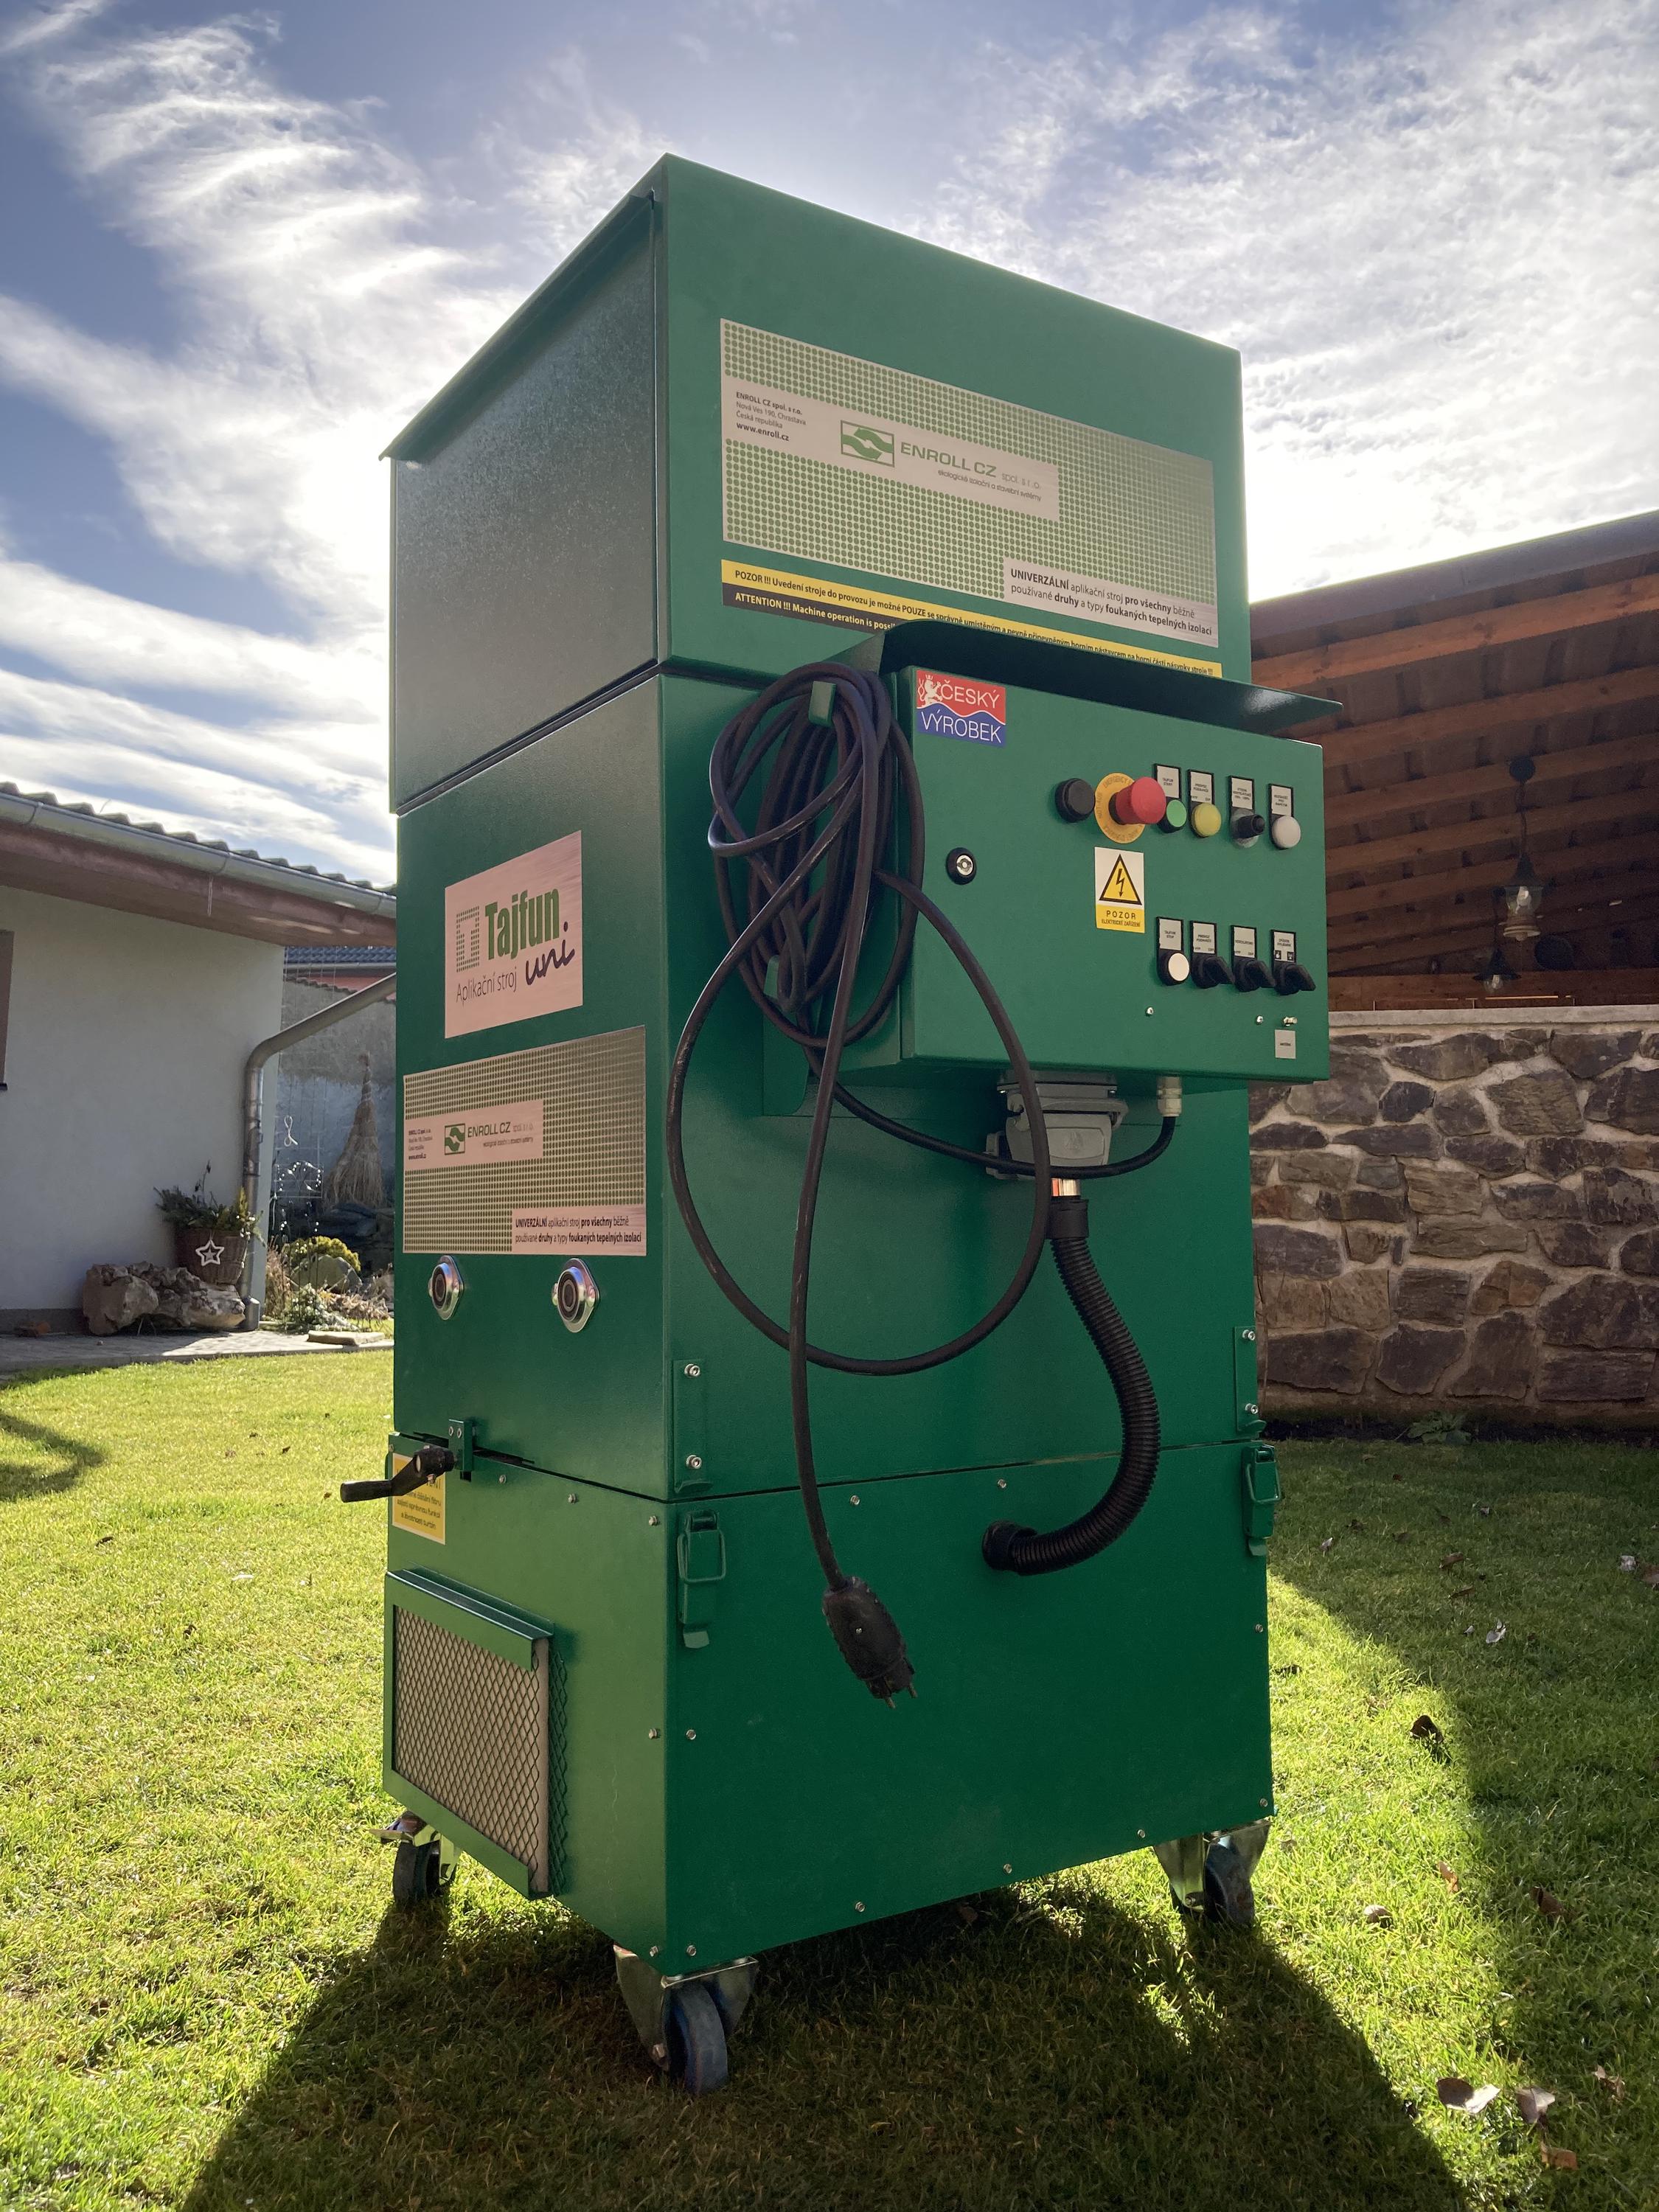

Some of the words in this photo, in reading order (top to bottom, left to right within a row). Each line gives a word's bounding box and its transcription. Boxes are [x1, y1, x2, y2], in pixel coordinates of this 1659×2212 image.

[737, 392, 761, 404] ENROLL
[773, 403, 787, 411] spol.
[737, 401, 751, 411] Nová
[778, 412, 806, 425] Chrastava
[737, 410, 754, 421] Česká
[755, 417, 782, 428] republika
[737, 422, 789, 442] www.enroll.cz
[901, 442, 970, 471] ENROLL
[974, 462, 997, 478] CZ
[1002, 473, 1019, 484] spol.
[735, 570, 762, 584] POZOR
[773, 578, 804, 592] Uvedení
[805, 584, 826, 597] stroje
[828, 588, 837, 599] do
[838, 591, 868, 605] provozu
[869, 598, 876, 608] je
[877, 599, 901, 612] možné
[902, 605, 926, 617] POUZE
[735, 592, 782, 609] ATTENTION
[783, 601, 791, 611] !!!
[793, 603, 826, 619] Machine
[827, 611, 865, 626] operation
[866, 616, 872, 627] is
[1011, 568, 1069, 589] UNIVERZÁLNÍ
[1071, 583, 1105, 598] aplikační
[1107, 591, 1123, 605] stroj
[1125, 597, 1138, 608] pro
[1141, 598, 1172, 614] všechny
[1173, 603, 1194, 619] běžně
[1012, 584, 1052, 602] používané
[1054, 593, 1079, 608] druhy
[1081, 599, 1085, 608] a
[1088, 601, 1104, 613] typy
[1106, 605, 1147, 622] foukaných
[1149, 614, 1186, 630] tepelných
[1189, 622, 1212, 636] izolací
[941, 679, 1000, 709] ČESKÝ
[921, 709, 1001, 744] VÝROBEK
[485, 888, 560, 960] Tajfun
[1106, 910, 1136, 920] POZOR
[526, 922, 575, 986] uni
[456, 971, 495, 1007] Aplikační
[498, 967, 517, 992] stroj
[467, 1124, 498, 1138] ENROLL
[500, 1121, 511, 1134] CZ
[515, 1217, 547, 1228] UNIVERZÁLNÍ
[548, 1218, 568, 1229] aplikační
[569, 1217, 580, 1228] stroj
[581, 1218, 590, 1228] pro
[591, 1217, 613, 1228] všechny
[613, 1216, 629, 1226] běžně
[538, 1233, 553, 1245] druhy
[557, 1234, 568, 1245] typy
[569, 1231, 596, 1245] foukaných
[597, 1231, 623, 1245] tepelných
[624, 1231, 641, 1242] izolací
